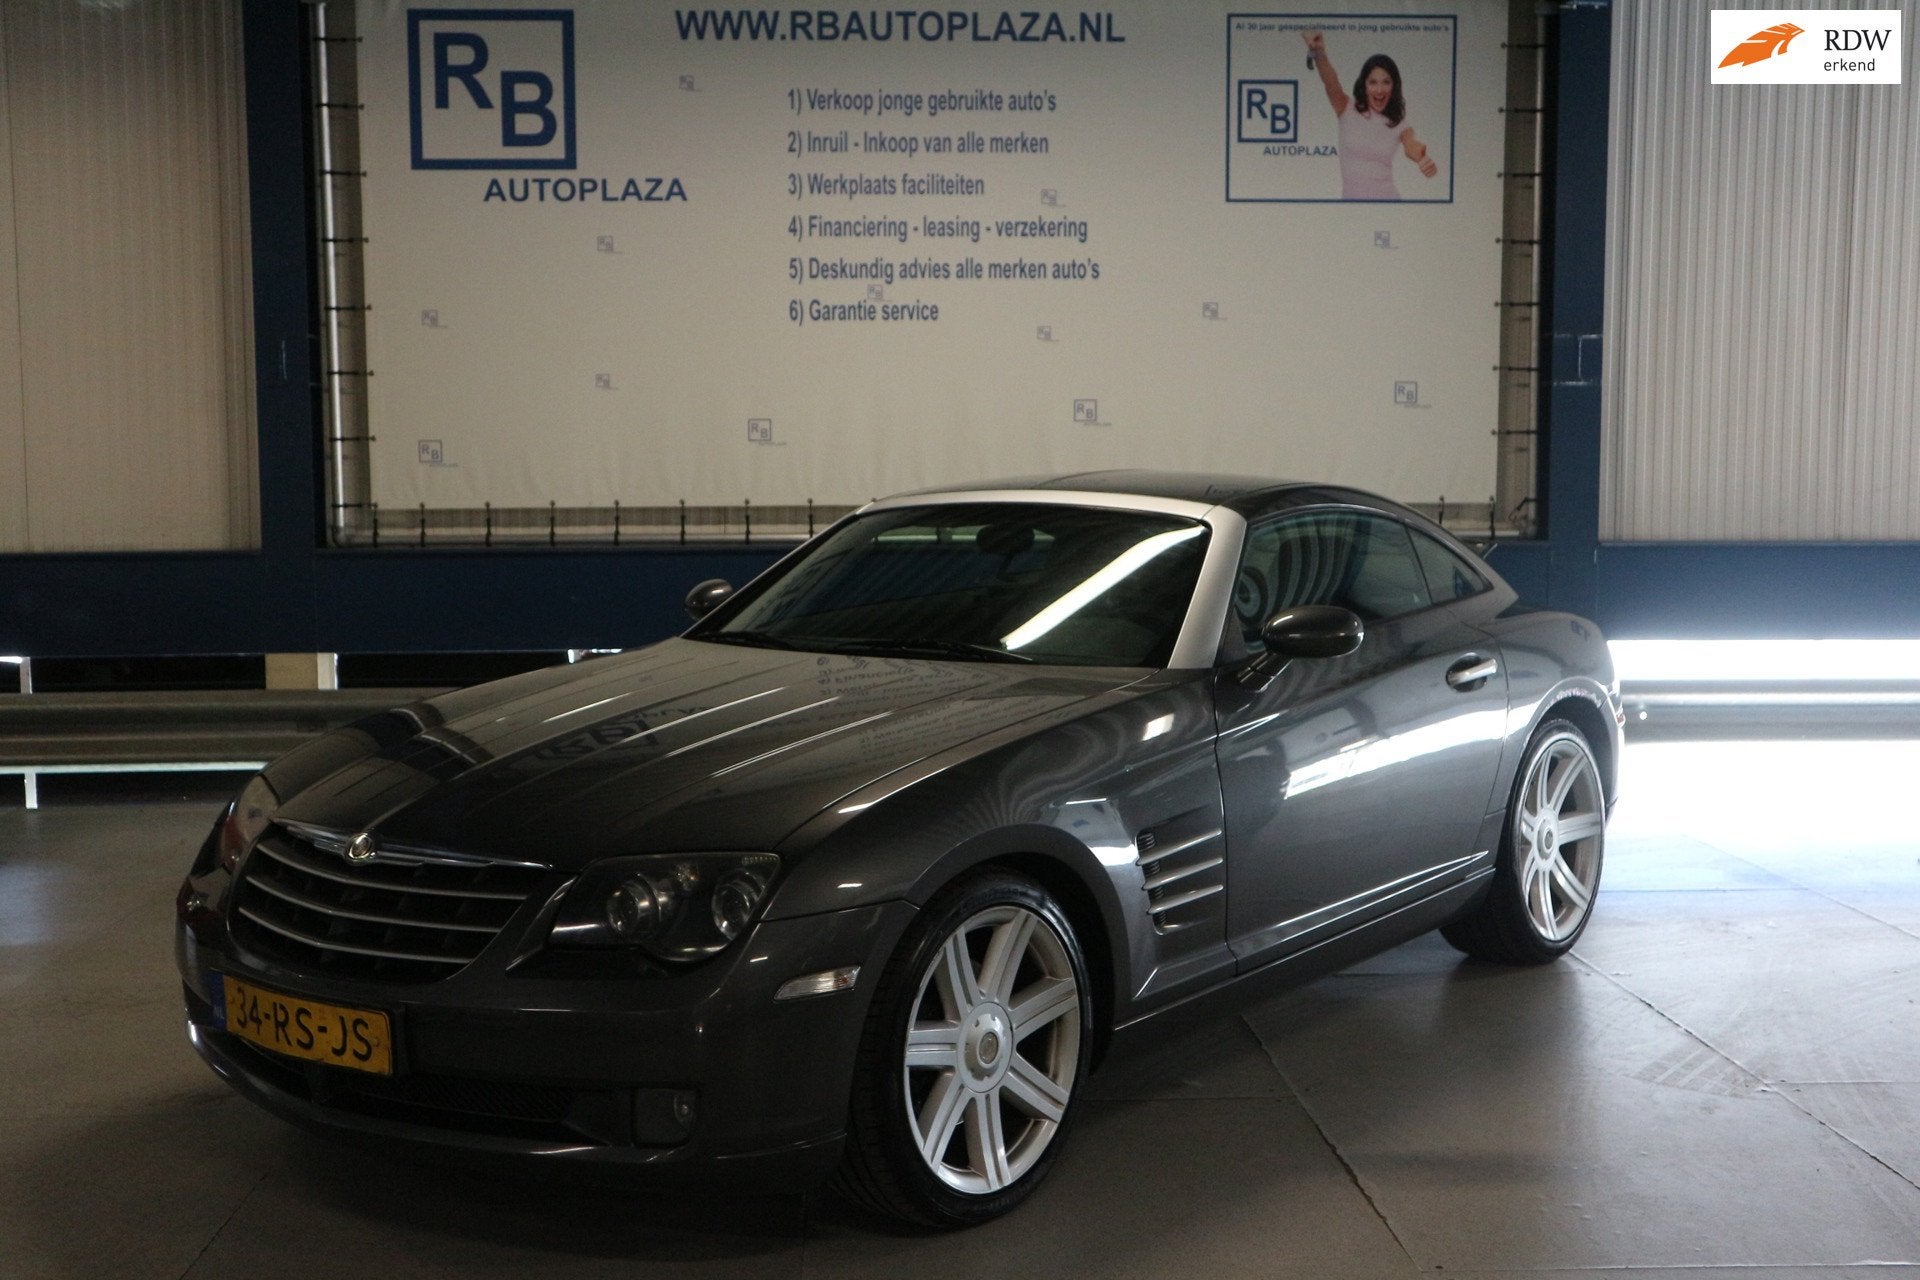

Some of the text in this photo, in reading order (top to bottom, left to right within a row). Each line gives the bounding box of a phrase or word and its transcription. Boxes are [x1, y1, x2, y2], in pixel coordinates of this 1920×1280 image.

[675, 9, 1125, 42] WWW.RBAUTOPLAZA.NL
[434, 32, 556, 147] RB
[788, 88, 1057, 117] 1) Verkoop jonge gebruikte auto's
[1246, 88, 1291, 134] RB
[788, 131, 802, 157] 2)
[808, 131, 848, 152] Inruil
[864, 131, 918, 157] Inkoop
[923, 136, 952, 153] van
[957, 131, 985, 153] alle
[990, 131, 1049, 153] merken
[1262, 145, 1338, 157] AUTOPLAZA
[483, 177, 687, 203] AUTOPLAZA
[788, 173, 985, 200] 3) Werkplaats faciliteiten
[788, 215, 803, 242] 4)
[808, 215, 908, 243] Financiering
[923, 215, 980, 243] leasing
[995, 215, 1088, 243] verzekering
[789, 257, 1100, 285] 5) Deskundig advies alle merken auto's
[789, 298, 939, 326] 6) Garantie service
[236, 986, 373, 1063] 34-RS-JS
